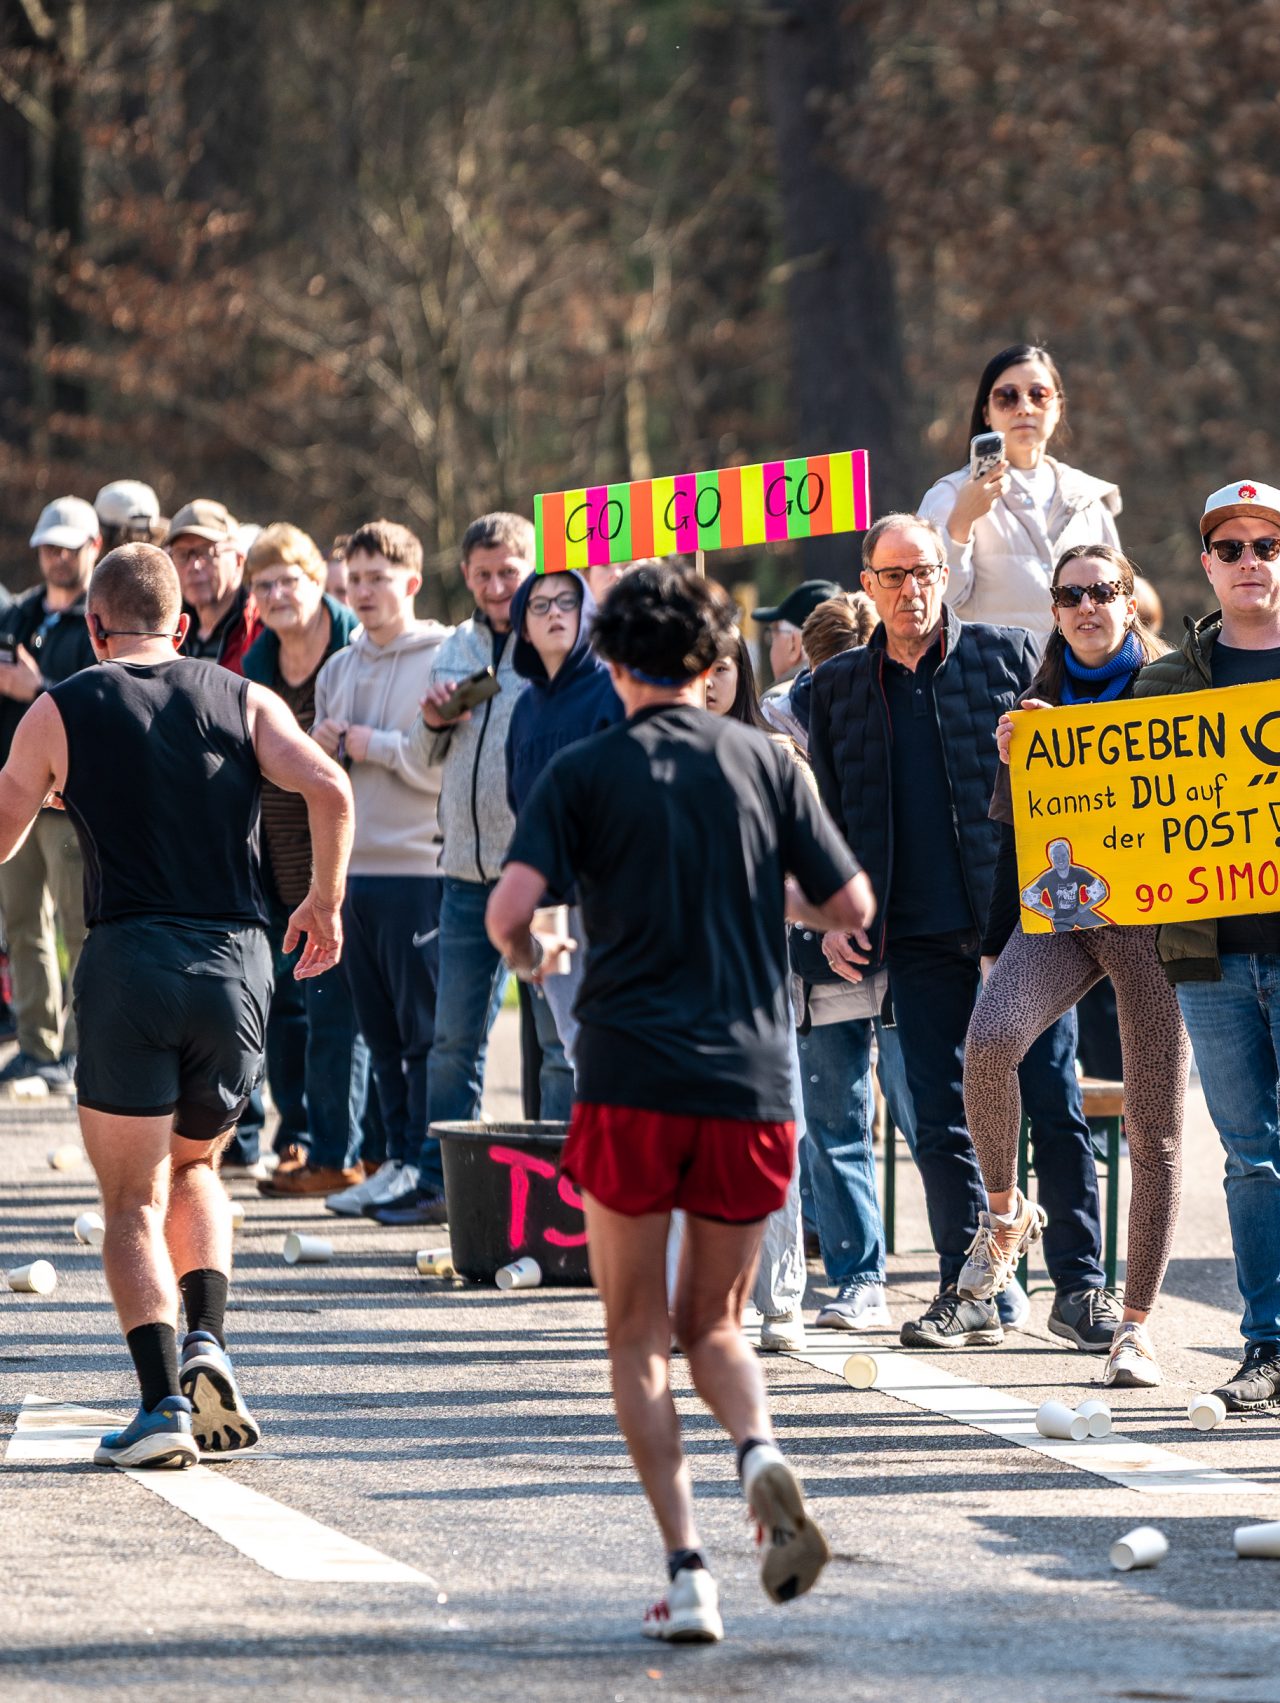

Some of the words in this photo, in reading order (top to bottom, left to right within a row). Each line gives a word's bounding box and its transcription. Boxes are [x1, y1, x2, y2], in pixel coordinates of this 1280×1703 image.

[566, 500, 623, 543] GO
[664, 486, 721, 531] GO
[765, 472, 824, 517] GO
[1026, 712, 1226, 771] AUFGEBEN
[1028, 785, 1117, 819] kannst
[1130, 774, 1176, 809] DU
[1186, 773, 1228, 809] auf
[1103, 825, 1145, 850] der
[1135, 883, 1173, 913] go
